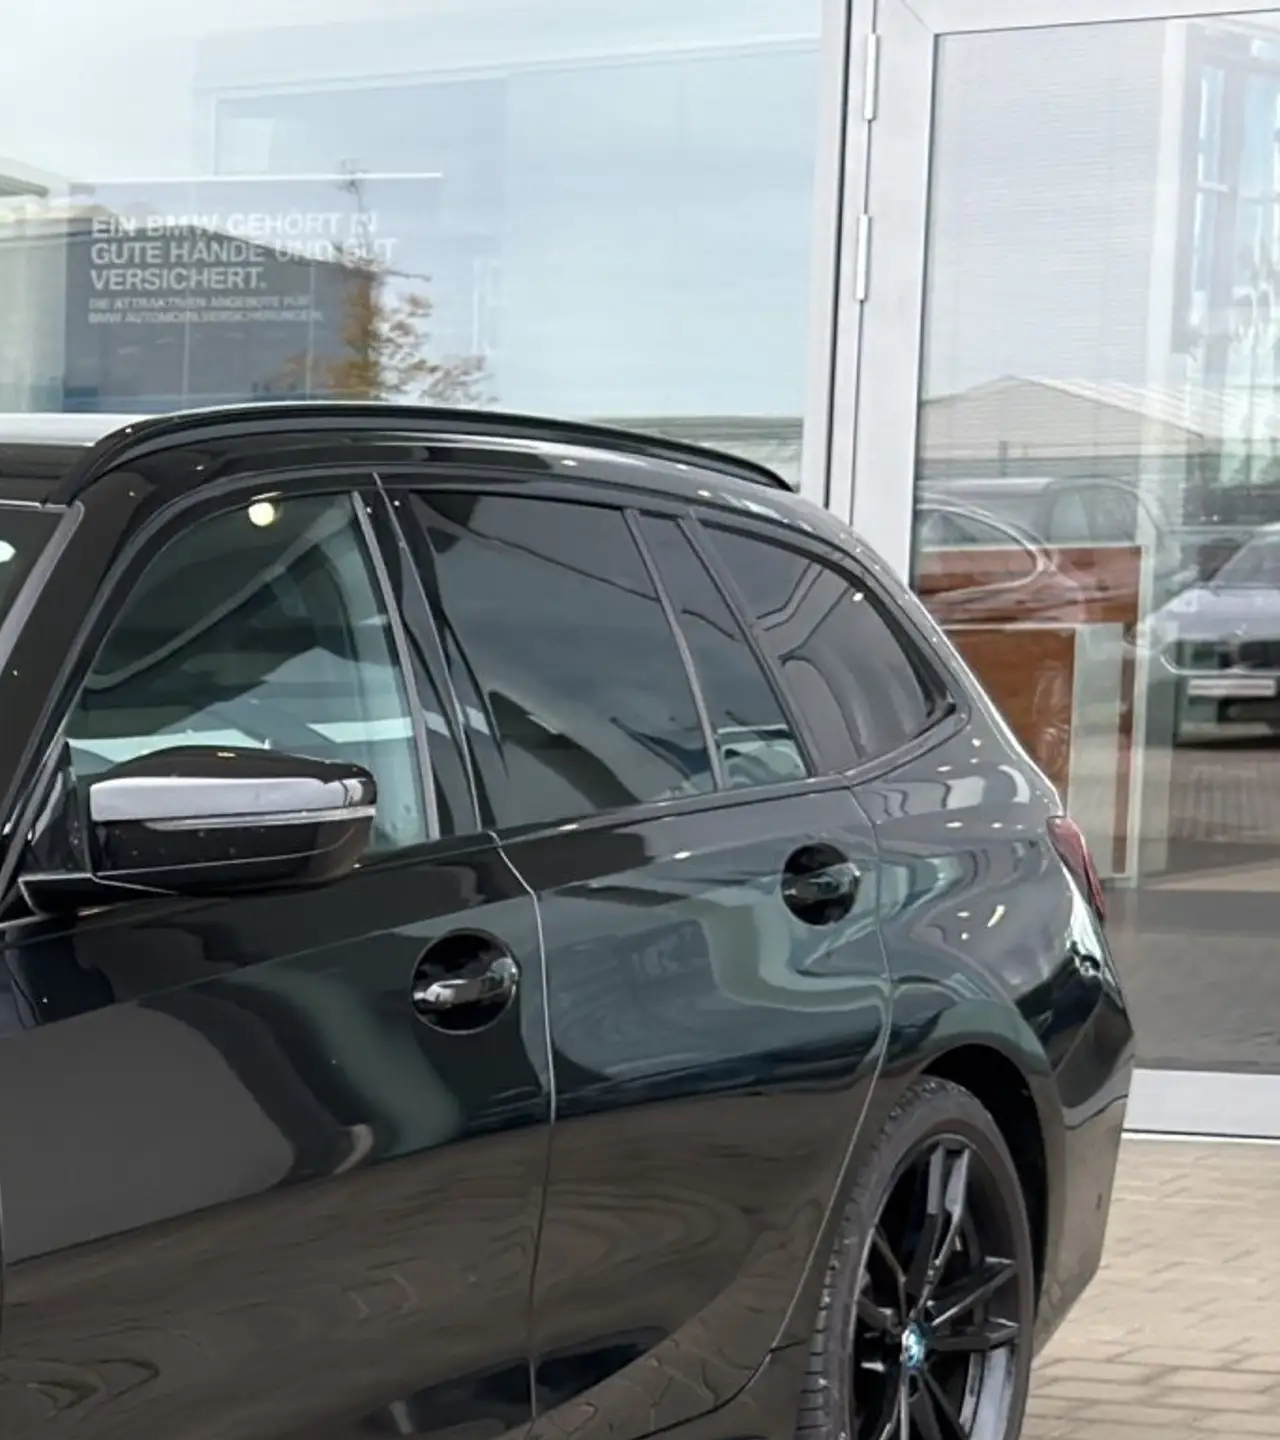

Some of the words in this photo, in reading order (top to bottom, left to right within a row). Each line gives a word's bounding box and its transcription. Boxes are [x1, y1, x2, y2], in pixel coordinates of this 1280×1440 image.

[91, 214, 137, 239] EIN
[146, 213, 219, 238] BMW
[350, 211, 378, 234] IN
[90, 241, 163, 265] GUTE
[274, 238, 333, 263] UND
[89, 266, 268, 292] VERSICHERT.
